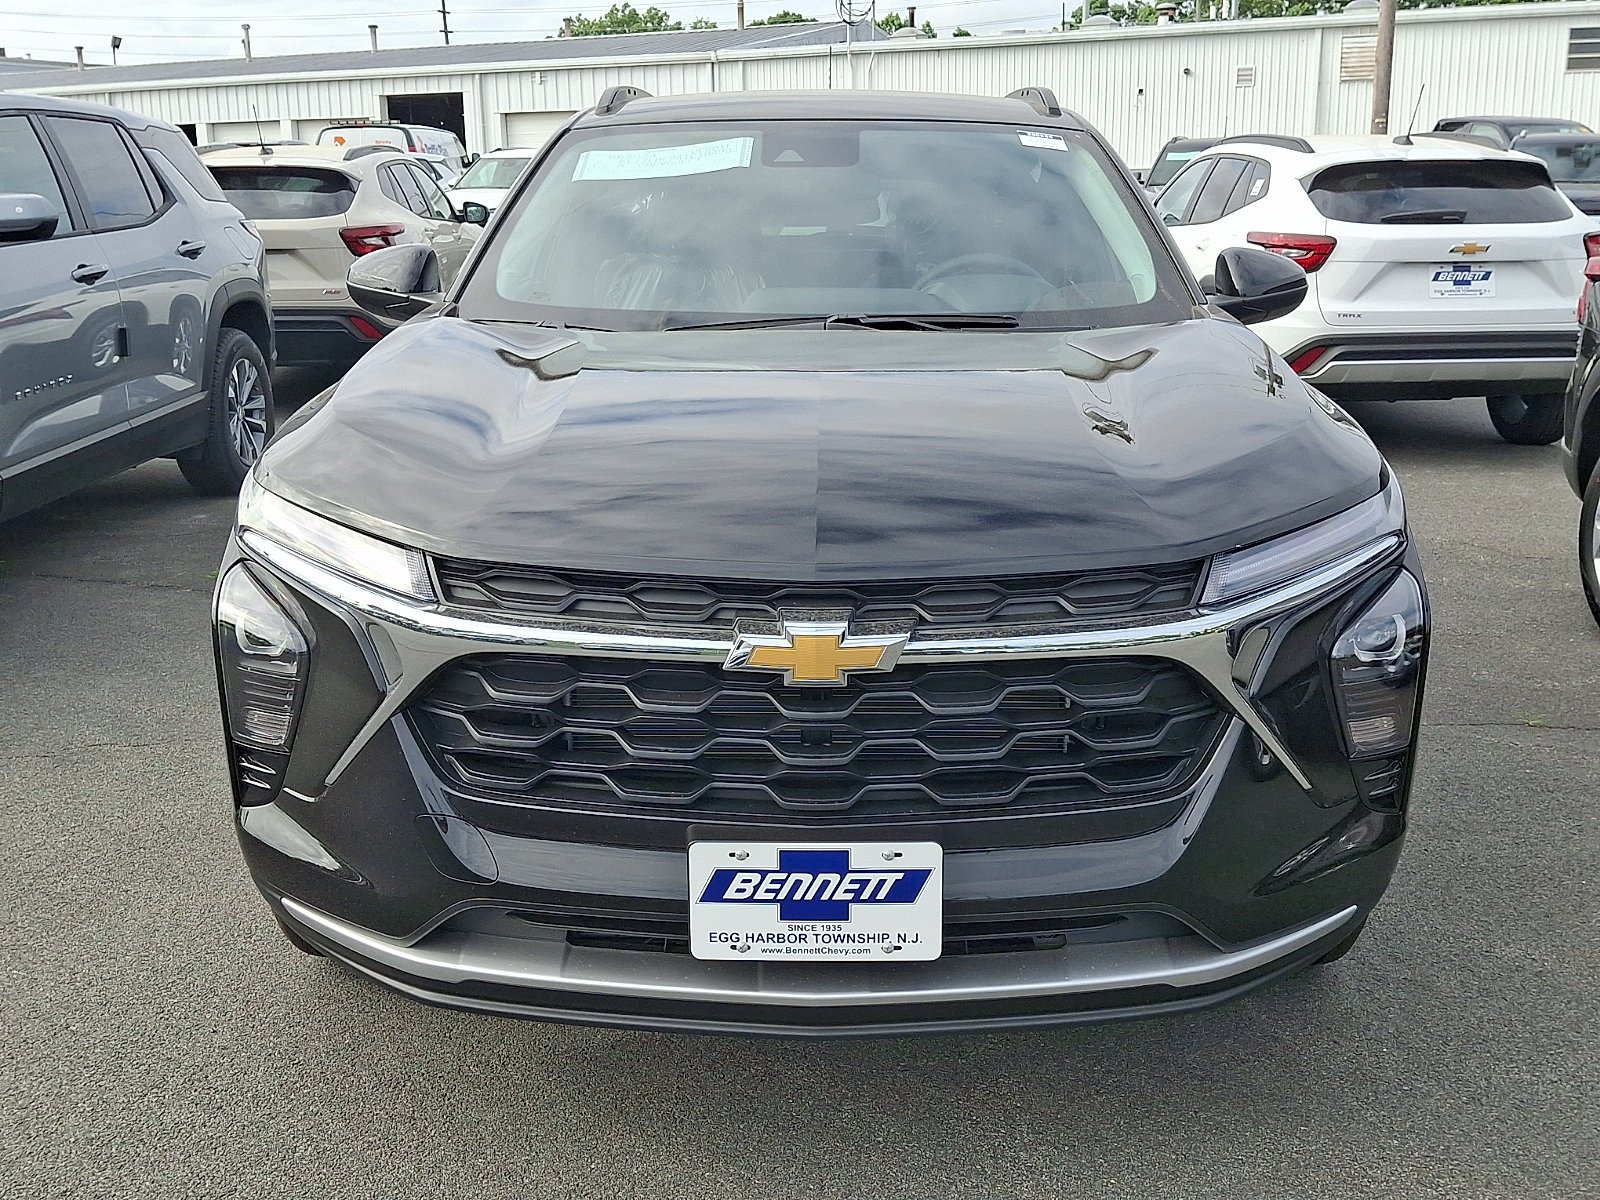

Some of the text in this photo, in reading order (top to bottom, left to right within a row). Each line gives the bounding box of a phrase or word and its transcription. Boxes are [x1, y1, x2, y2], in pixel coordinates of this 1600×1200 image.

[1437, 271, 1486, 281] BENNETT
[722, 872, 905, 901] BENNETT
[787, 924, 843, 932] SINCE 1935
[708, 932, 741, 944] EGG
[745, 932, 808, 945] HARBOR
[897, 932, 923, 944] N.J.
[760, 946, 871, 956] www.BennettChevy.com
